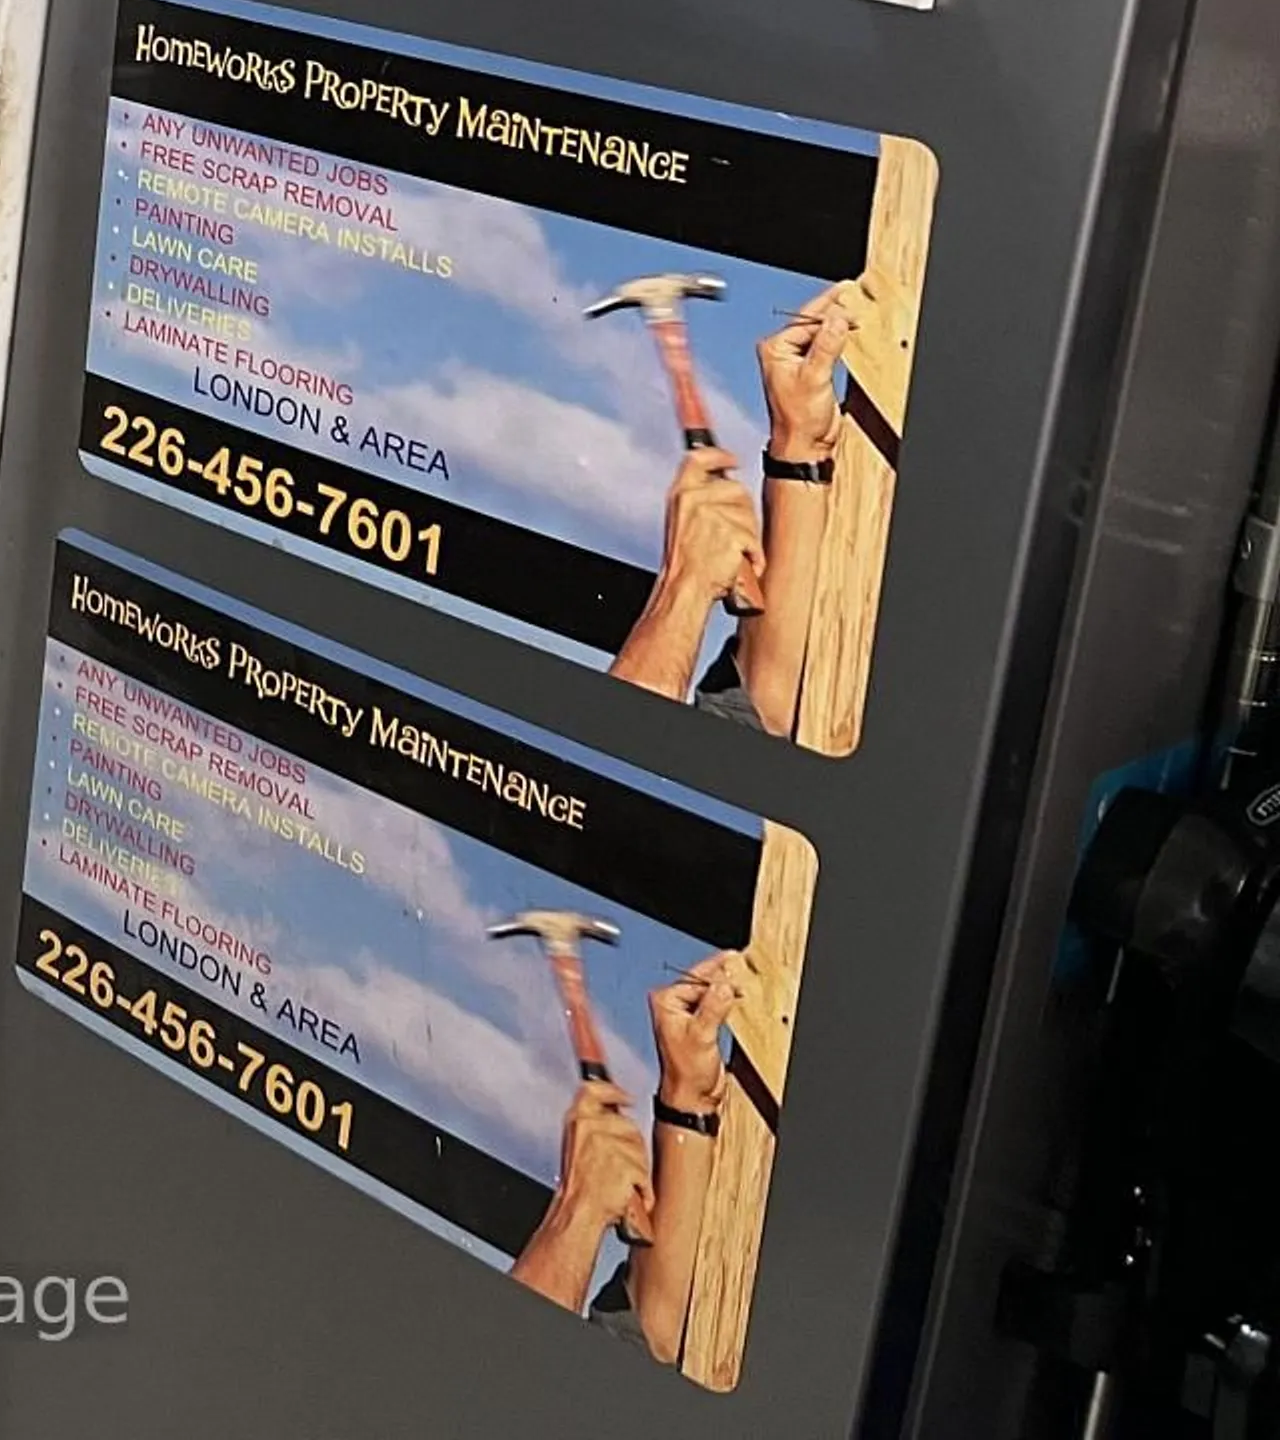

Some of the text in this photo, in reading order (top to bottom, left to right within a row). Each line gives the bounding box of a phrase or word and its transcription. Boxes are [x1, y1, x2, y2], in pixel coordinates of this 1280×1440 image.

[141, 110, 389, 196] ANY UNWANTED JOBS
[141, 140, 400, 232] FREE SCRAP REMOVAL
[131, 225, 258, 285] LAWN CARE
[134, 197, 235, 245] PAINTING
[137, 169, 454, 280] REMOTE CAMERA INSTALLS
[126, 282, 252, 340] DELIVERIES
[128, 254, 270, 317] DRYWALLING
[124, 310, 354, 406] LAMINATE FLOORING
[192, 365, 451, 481] LONDON & AREA
[99, 404, 443, 577] 226-456-7601
[68, 737, 163, 802] PAINTING
[74, 686, 316, 820] FREE SCRAP REMOVAL
[77, 659, 307, 786] ANY UNWANTED JOBS
[63, 789, 195, 876] DRYWALLING
[66, 767, 186, 840] LAWN CARE
[71, 712, 365, 875] REMOTE CAMERA INSTALLS
[59, 842, 273, 976] LAMINATE FLOORING
[122, 908, 361, 1064] LONDON & AREA
[34, 928, 355, 1151] 226-456-7601
